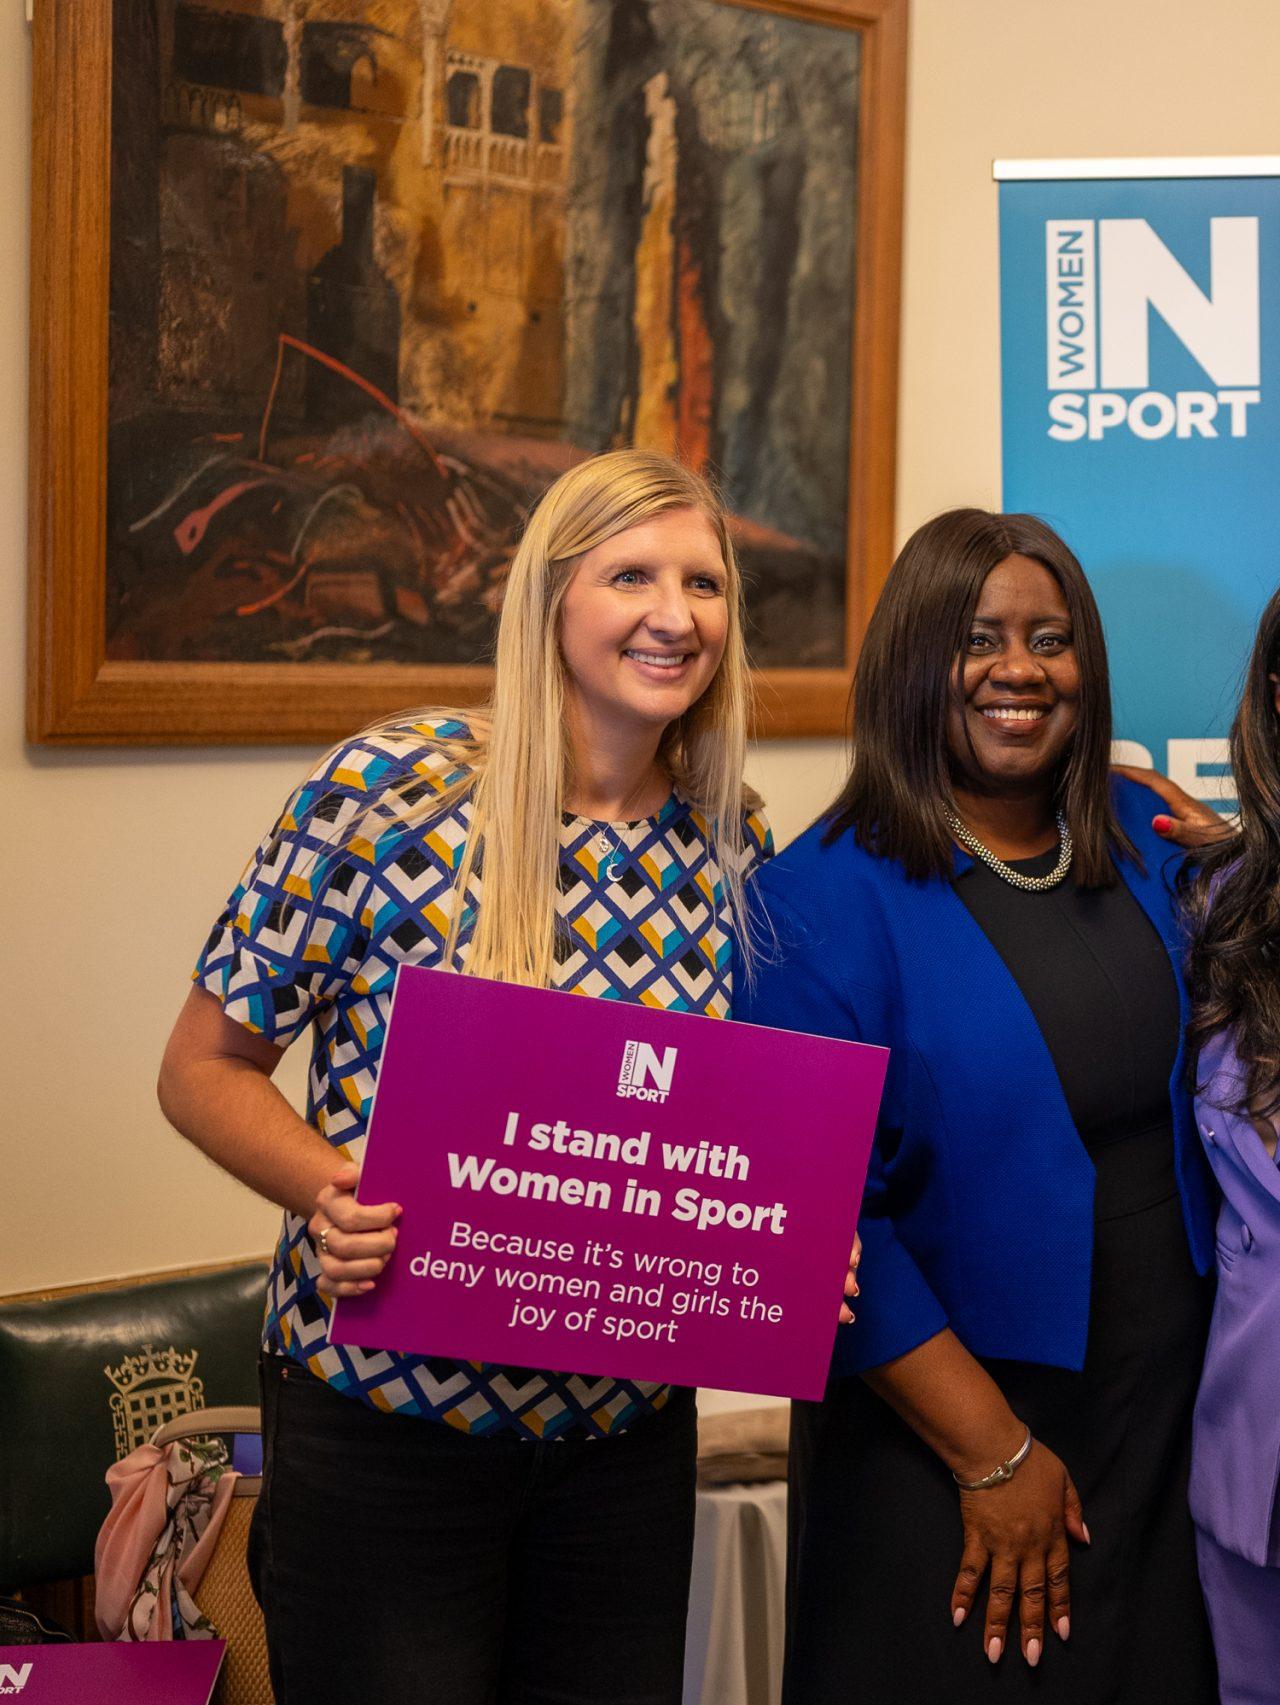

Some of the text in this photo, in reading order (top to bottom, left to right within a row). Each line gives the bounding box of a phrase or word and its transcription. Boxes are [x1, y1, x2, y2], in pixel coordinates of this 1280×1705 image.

[1057, 230, 1085, 379] WOMEN
[1047, 391, 1261, 442] SPORT
[616, 1085, 670, 1104] SPORT
[622, 1043, 635, 1081] WOMEN
[504, 1112, 749, 1181] I stand with
[448, 1153, 787, 1235] Women in Sport
[450, 1222, 759, 1287] Because it's wrong to
[410, 1252, 783, 1323] deny women and girls the
[509, 1299, 678, 1344] joy of sport
